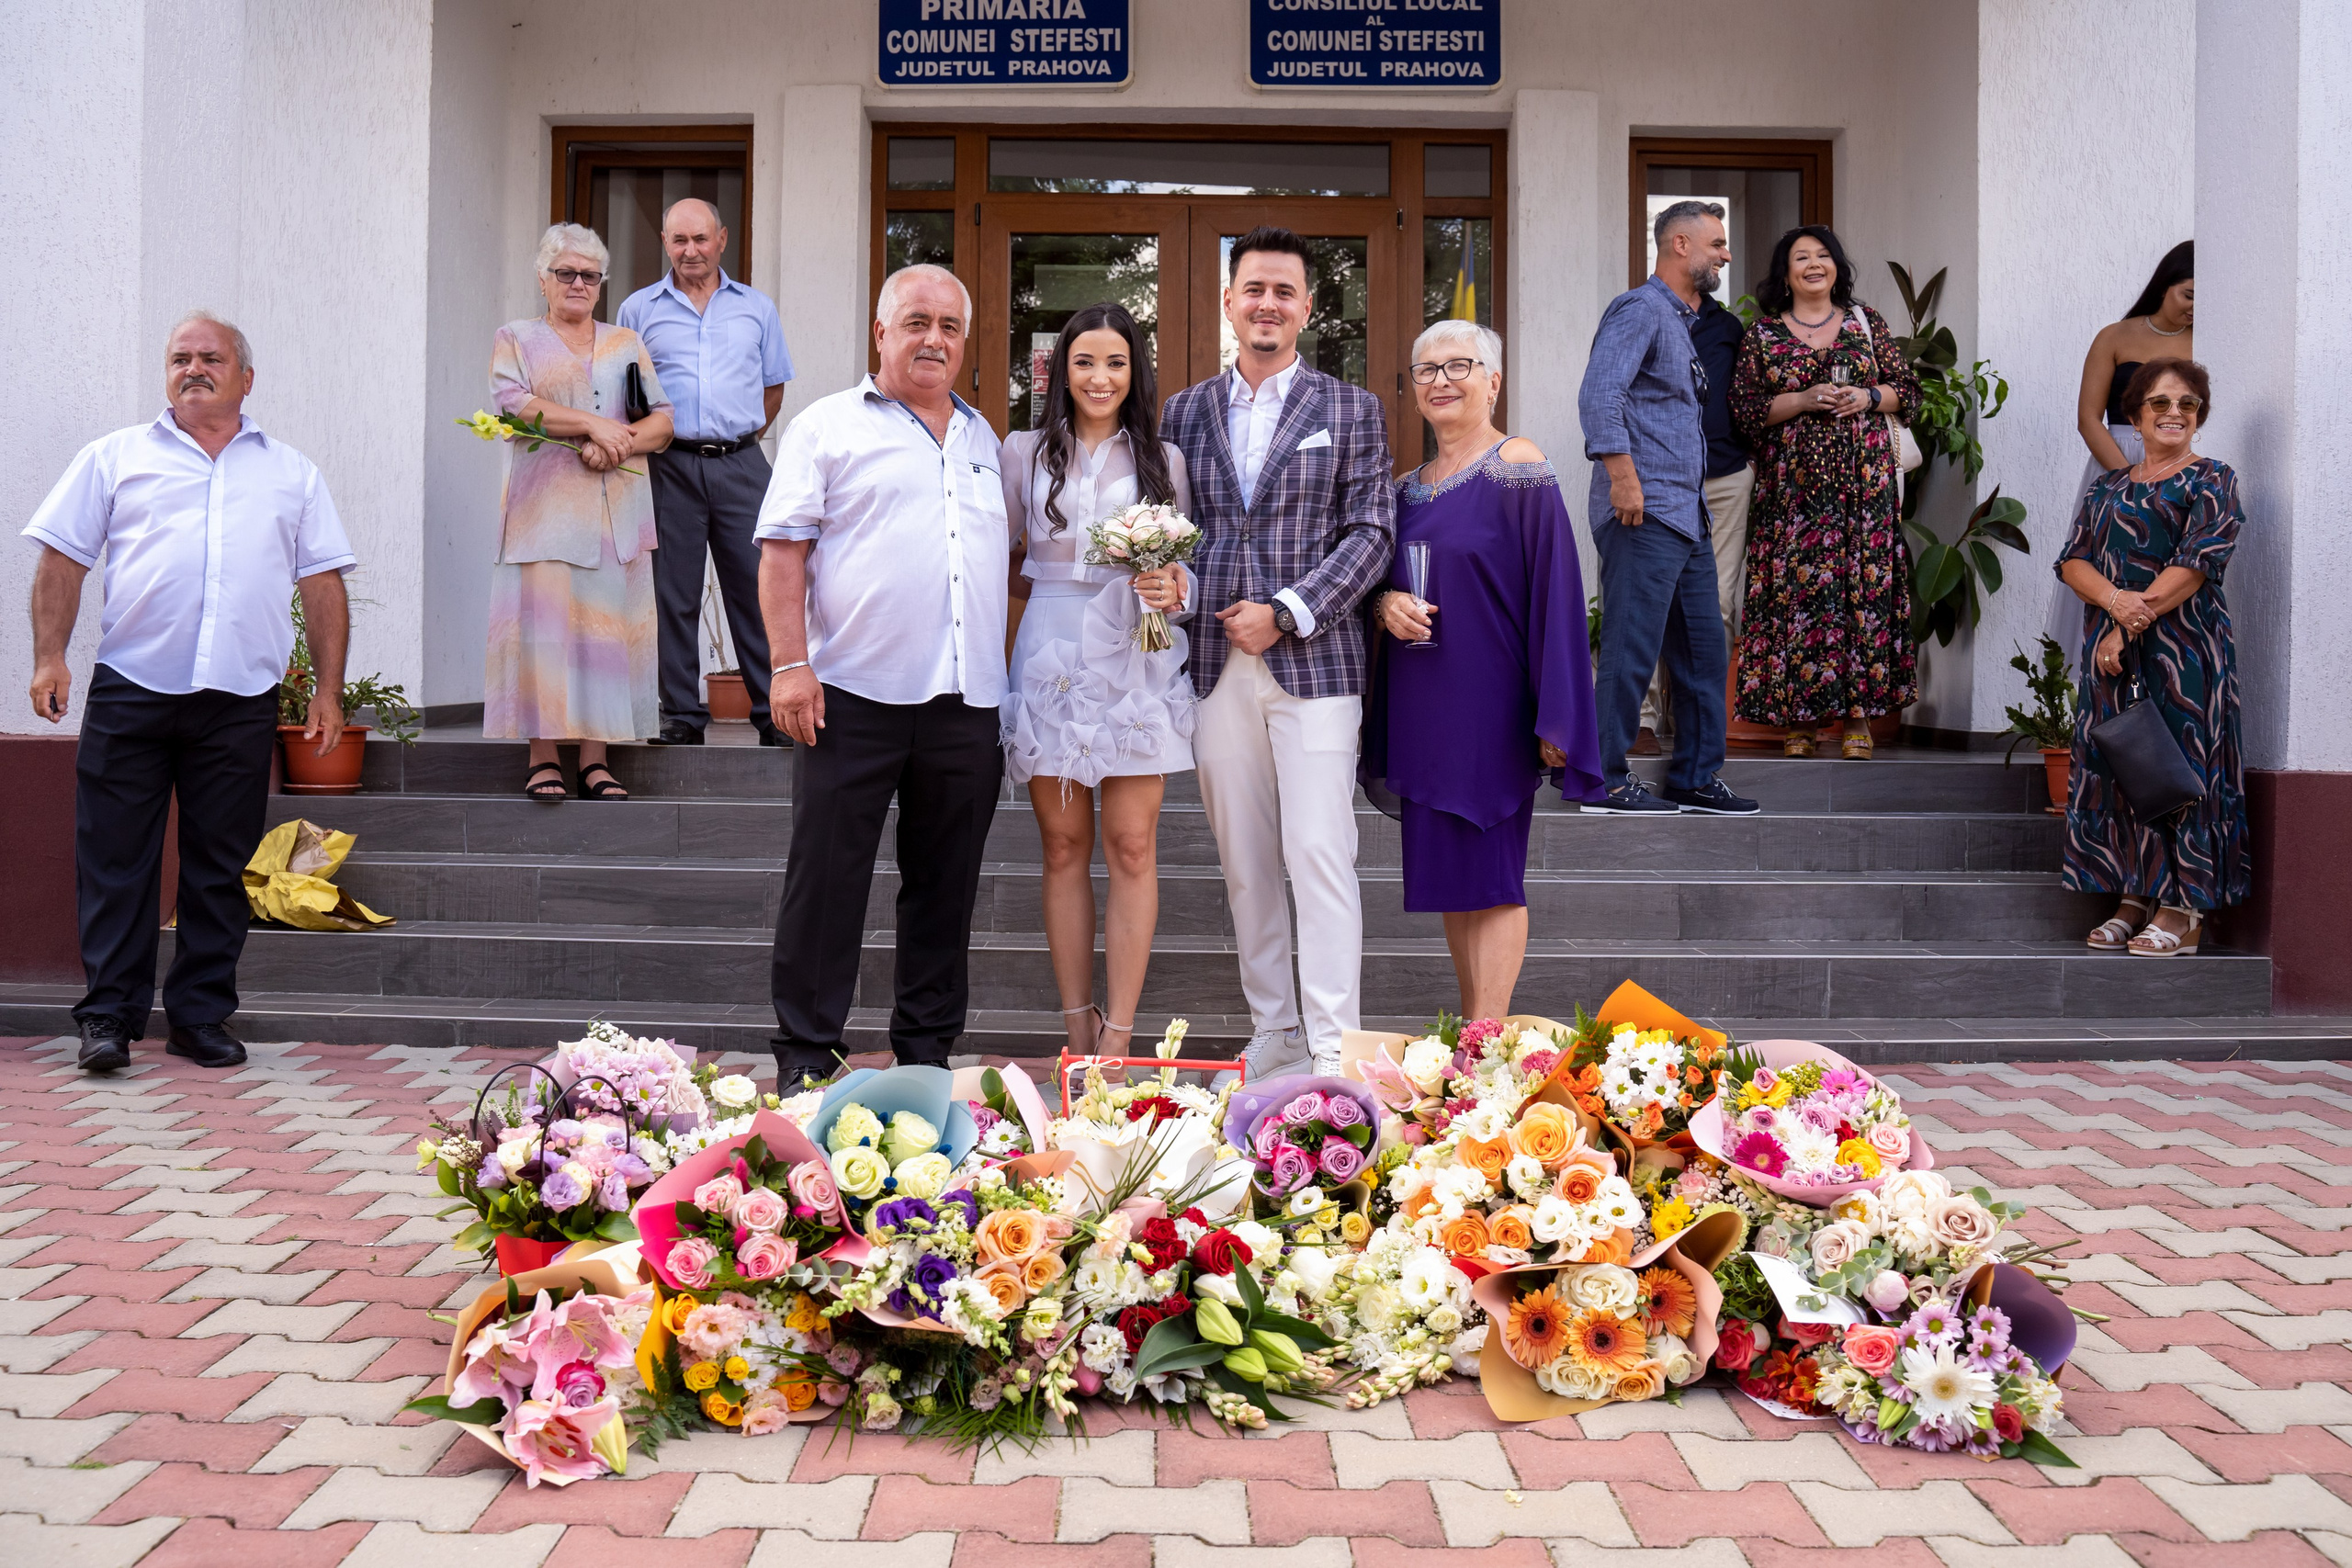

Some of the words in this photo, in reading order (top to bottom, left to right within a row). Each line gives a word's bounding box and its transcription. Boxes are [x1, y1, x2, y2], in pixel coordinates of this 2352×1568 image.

[922, 0, 1086, 20] PRIMARIA
[1366, 16, 1385, 25] AL
[887, 29, 995, 53] COMUNEI
[1011, 28, 1120, 51] STEFESTI
[1268, 30, 1371, 51] COMUNEI
[1379, 30, 1484, 51] STEFESTI
[896, 61, 994, 76] JUDETUL
[1009, 60, 1111, 75] PRAHOVA
[1267, 62, 1367, 76] JUDETUL
[1381, 62, 1484, 76] PRAHOVA
